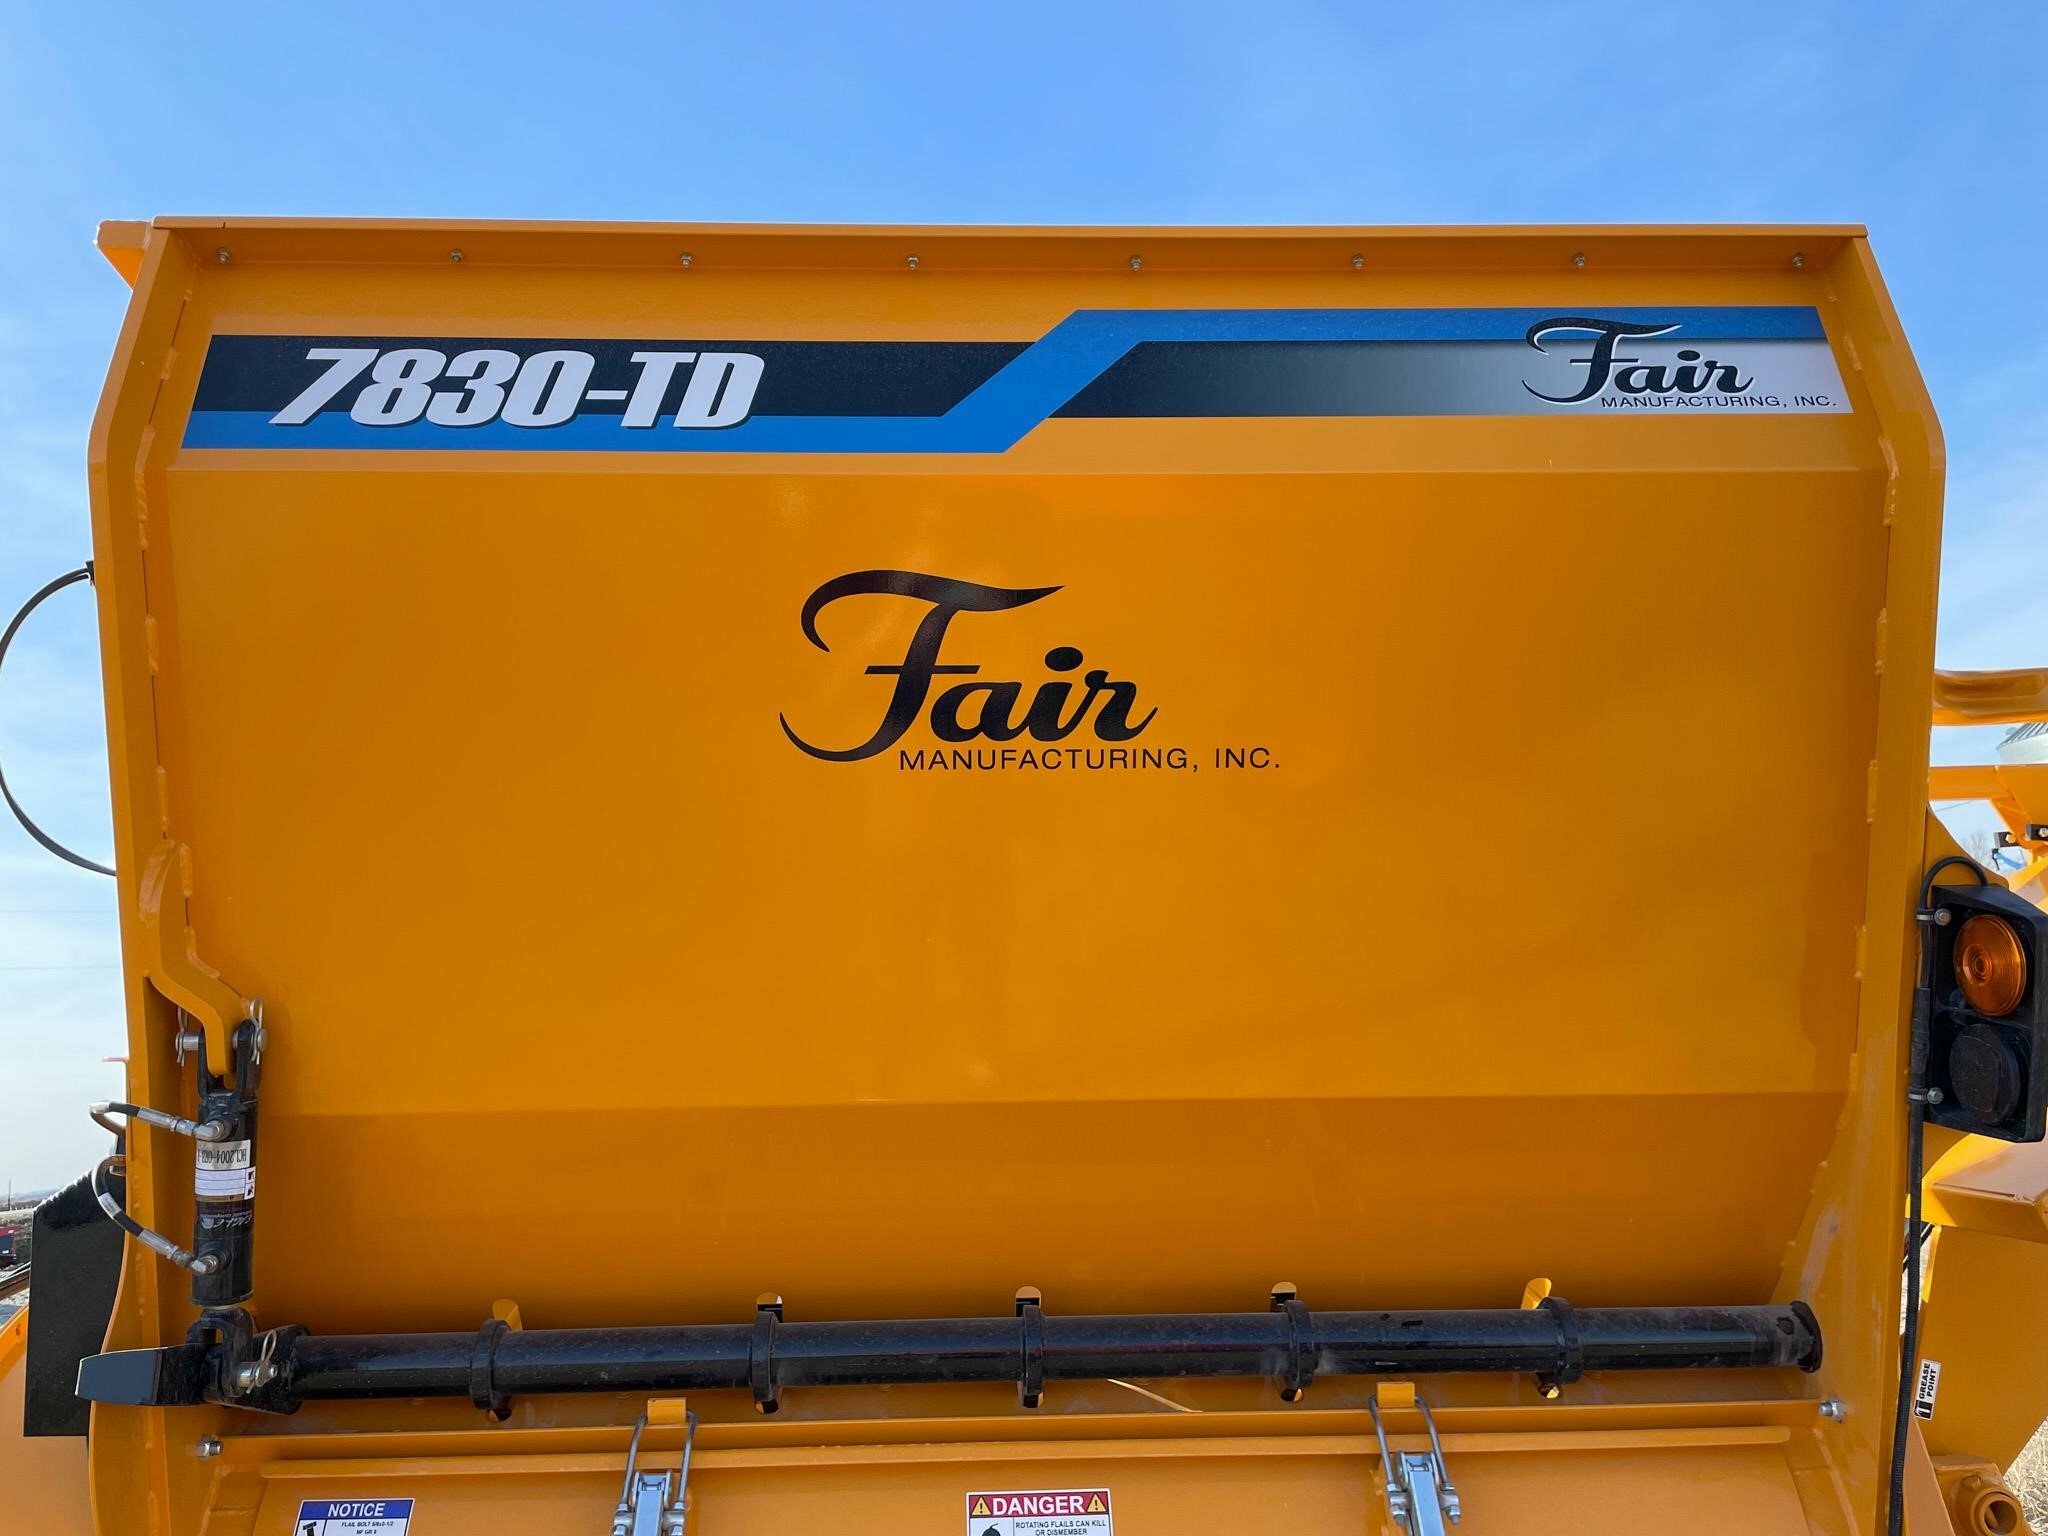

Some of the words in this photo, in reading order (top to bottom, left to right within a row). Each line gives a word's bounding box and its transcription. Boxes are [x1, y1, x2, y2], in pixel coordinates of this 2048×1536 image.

[1522, 317, 1755, 404] Fair
[268, 348, 766, 428] 7830-TD
[1601, 395, 1788, 408] MANUFACTURING,
[1794, 394, 1837, 407] INC.
[779, 569, 1159, 762] Fair
[899, 748, 1199, 773] MANUFACTURING,
[1215, 747, 1281, 769] INC.
[1919, 1363, 1930, 1399] GREASE
[1926, 1369, 1936, 1397] POINT
[327, 1502, 385, 1517] NOTICE
[992, 1495, 1085, 1515] DANGER
[1015, 1521, 1049, 1529] ROTATING
[1050, 1520, 1074, 1528] FLAILS
[1091, 1519, 1107, 1527] KILL
[1045, 1528, 1087, 1536] DISMEMBER
